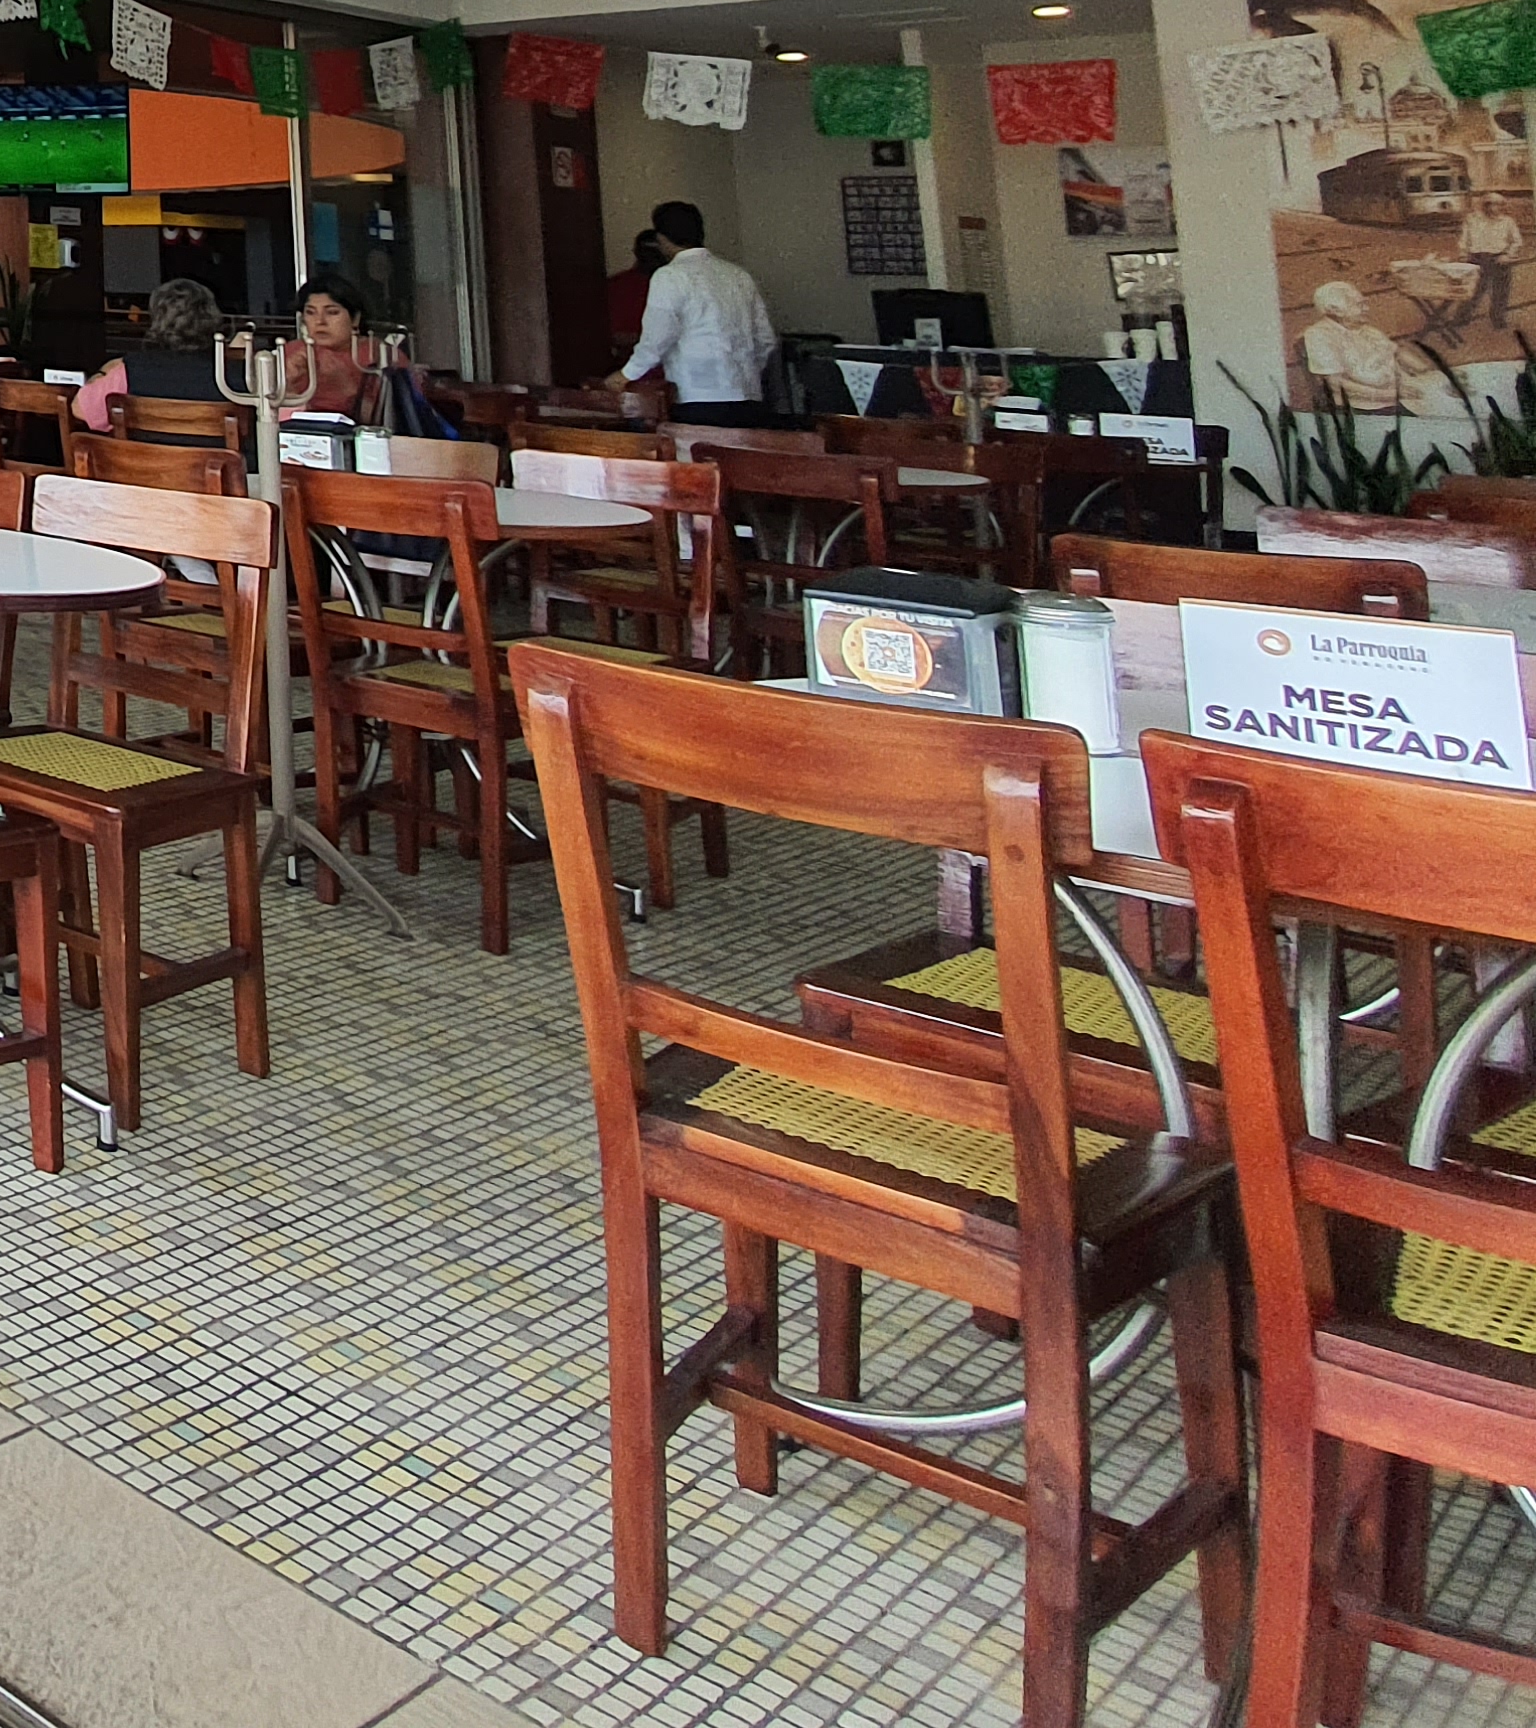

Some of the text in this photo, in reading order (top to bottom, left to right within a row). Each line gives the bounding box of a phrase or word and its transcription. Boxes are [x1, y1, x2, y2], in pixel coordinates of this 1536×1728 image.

[897, 611, 916, 623] TU
[1310, 633, 1333, 654] La
[1336, 636, 1428, 664] Parroquia
[1281, 684, 1414, 724] MESA
[1204, 703, 1511, 771] SANITIZADA
